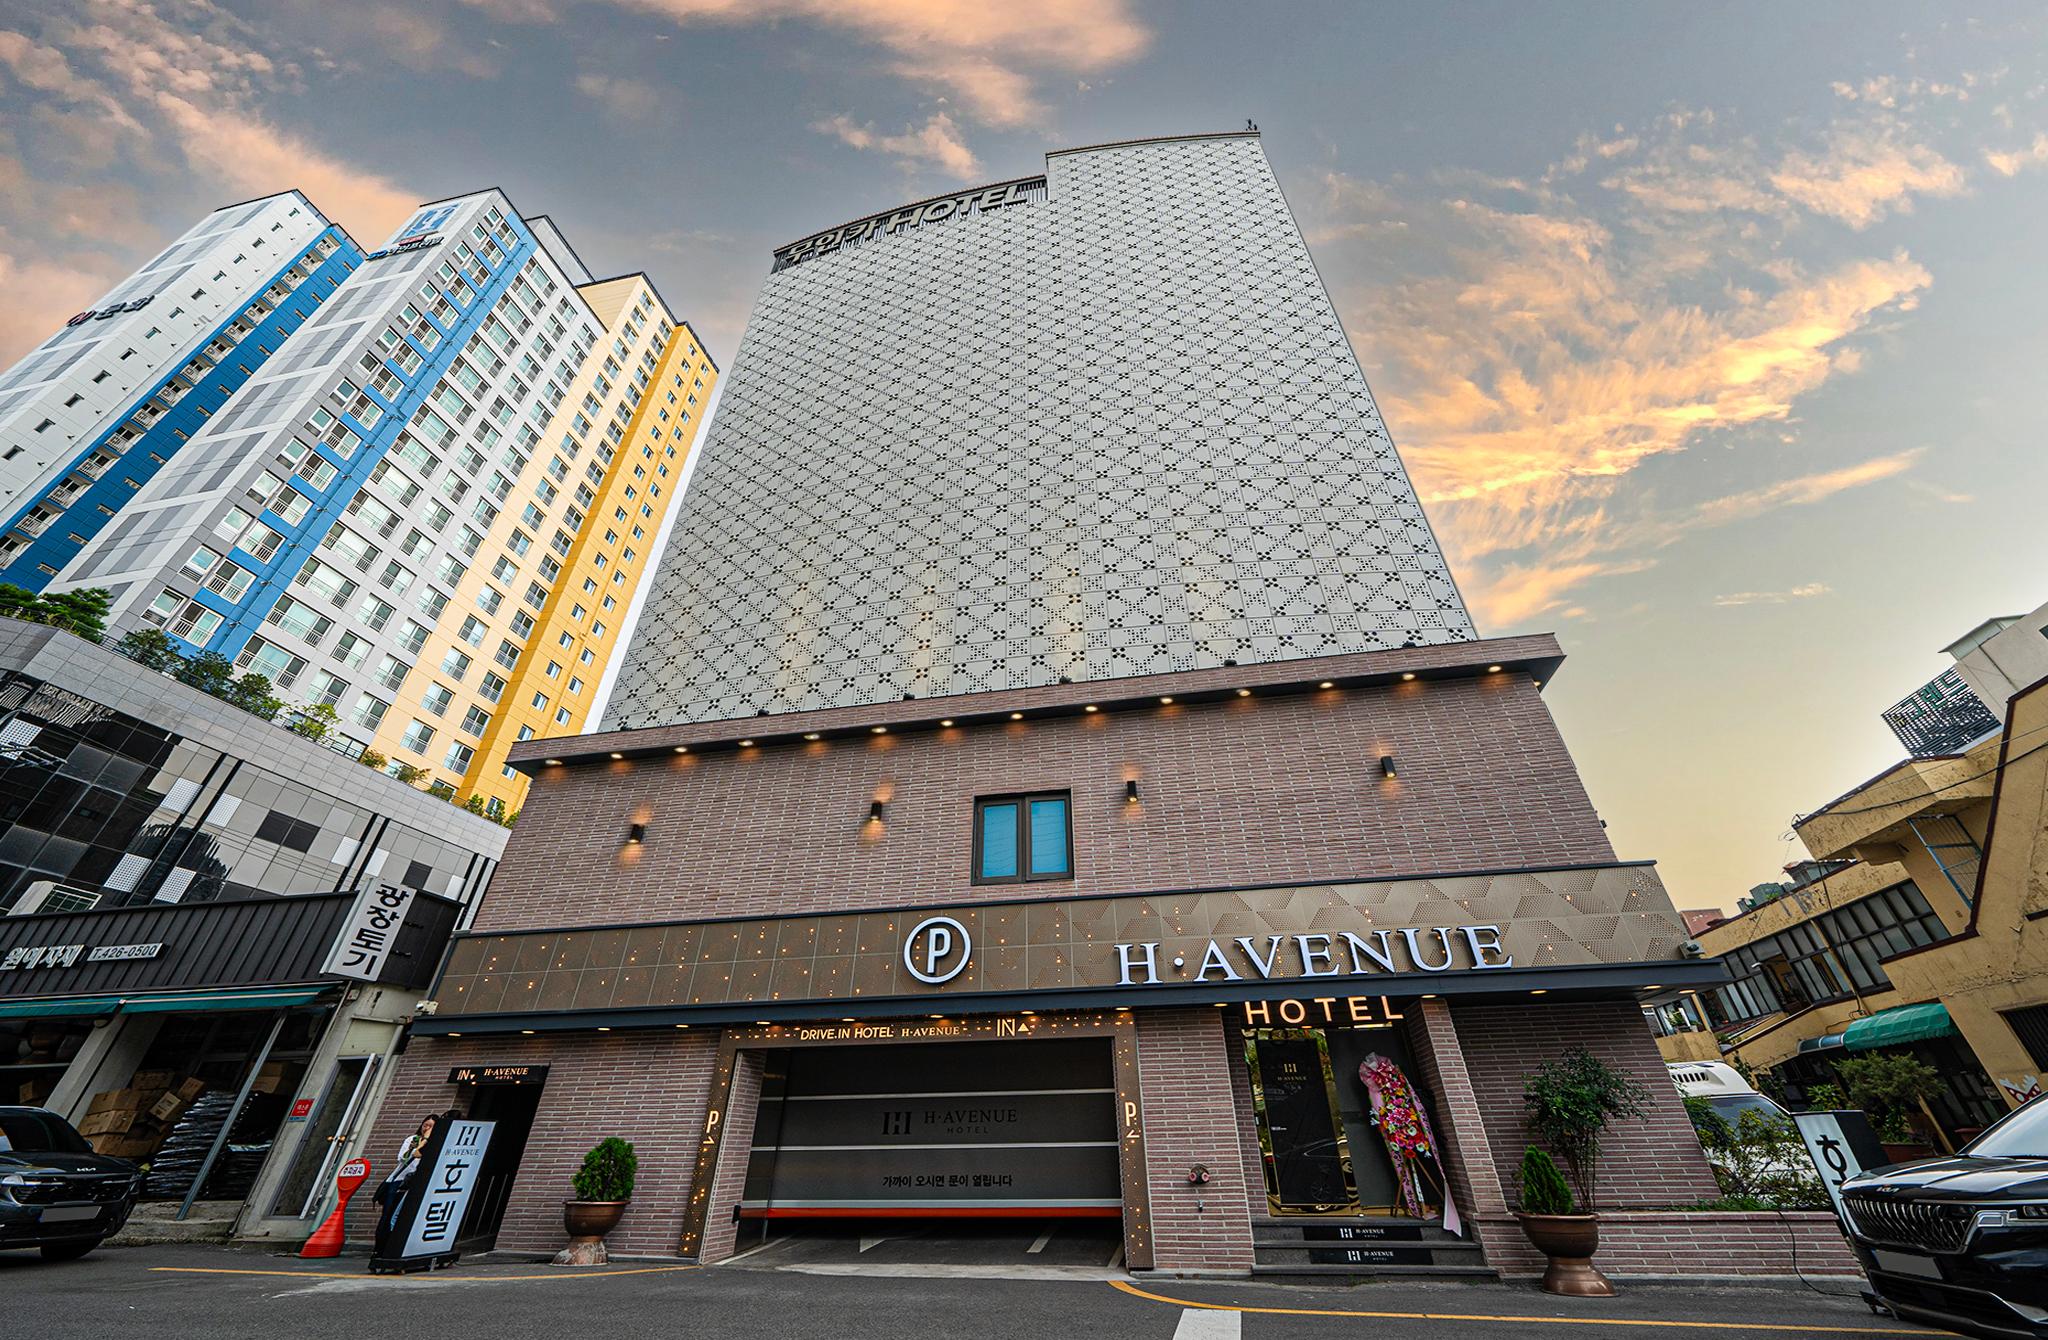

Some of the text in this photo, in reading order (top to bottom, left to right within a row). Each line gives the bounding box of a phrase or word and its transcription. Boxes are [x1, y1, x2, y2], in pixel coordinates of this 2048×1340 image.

[887, 185, 1028, 233] HOTEL
[342, 883, 410, 976] 광장토기
[926, 927, 952, 975] P
[1244, 994, 1404, 1025] HOTEL
[854, 1025, 894, 1039] HOTEL
[996, 1018, 1016, 1037] IN
[456, 1069, 471, 1081] IN
[706, 1110, 720, 1134] P
[1124, 1101, 1137, 1127] P
[946, 1126, 989, 1134] HOTEL
[882, 1175, 912, 1188] 가까이
[948, 1174, 969, 1187] 문이
[421, 1158, 470, 1242] 호텔
